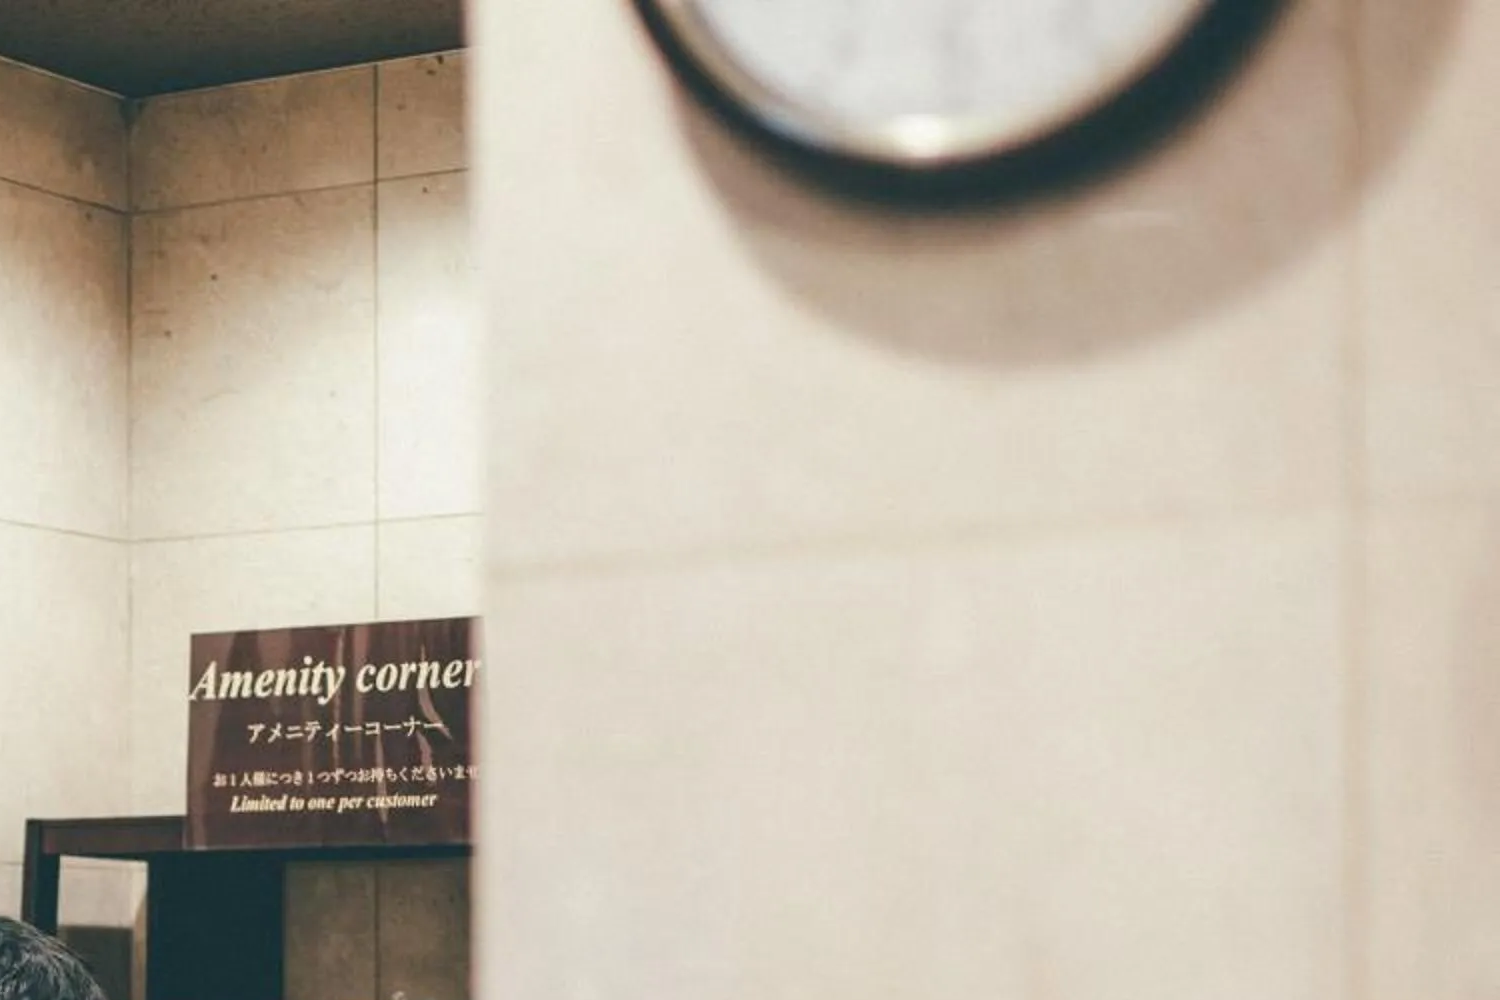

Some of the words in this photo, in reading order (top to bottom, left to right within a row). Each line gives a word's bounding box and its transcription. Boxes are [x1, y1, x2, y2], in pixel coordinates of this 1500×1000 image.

[188, 656, 345, 704] Amenity
[356, 658, 481, 694] corner
[248, 715, 444, 743] アメニティーコーナー
[230, 794, 288, 813] Limited
[289, 795, 306, 811] to
[307, 798, 335, 811] one
[337, 796, 366, 813] per
[366, 792, 438, 809] customer
